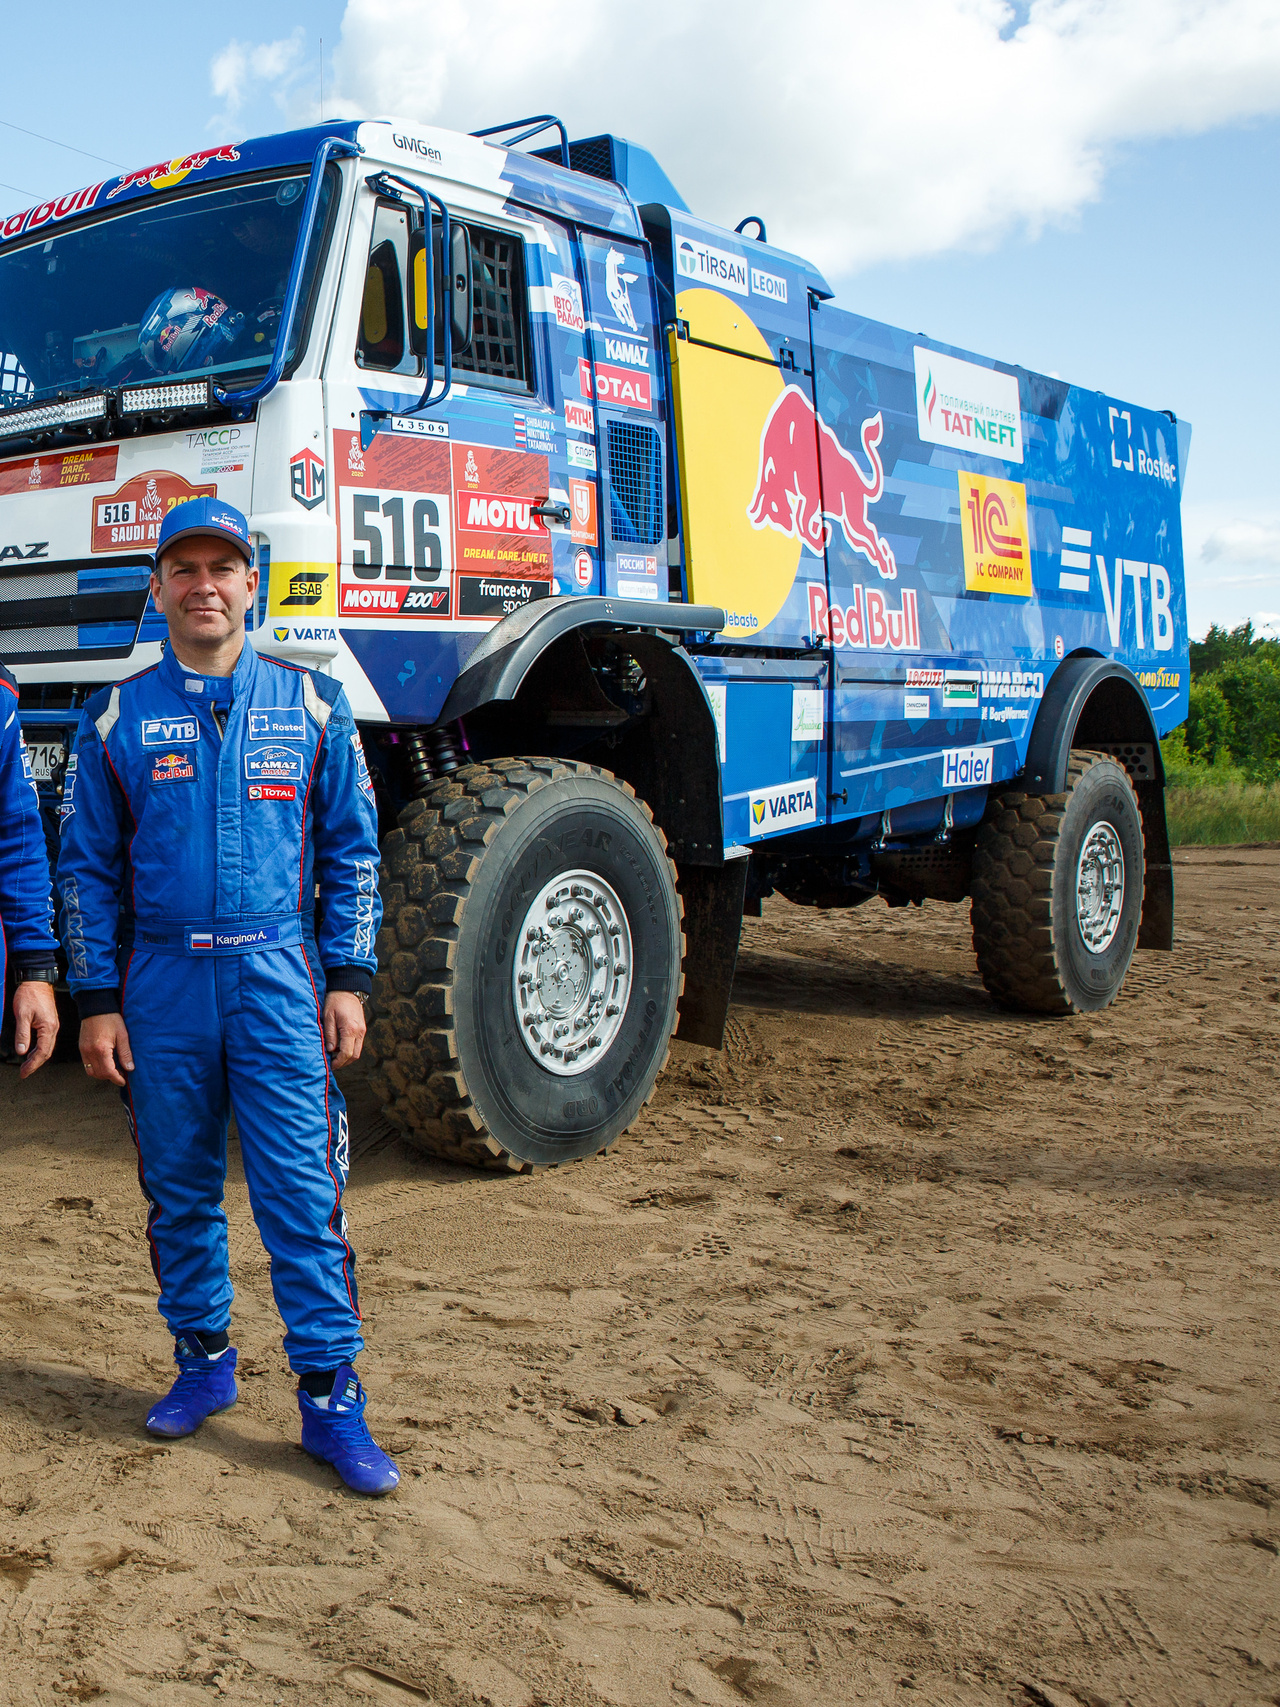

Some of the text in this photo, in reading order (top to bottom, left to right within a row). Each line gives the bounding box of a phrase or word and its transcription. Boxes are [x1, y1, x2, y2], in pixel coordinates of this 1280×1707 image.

[392, 133, 442, 161] GMGen
[753, 272, 786, 299] LEONI
[557, 311, 583, 330] РАДИО
[605, 338, 649, 367] KAMAZ
[581, 366, 648, 404] TOTAL
[940, 393, 1016, 424] ТОПЛИВНЫЙ ПАРТНЕР
[940, 408, 1017, 448] TATNEFT
[62, 452, 94, 466] DREAM.
[1137, 448, 1177, 482] Rostec
[60, 464, 86, 475] DARE.
[60, 472, 91, 485] LIVE IT.
[103, 505, 130, 523] 516
[111, 528, 144, 543] SAUDI
[352, 493, 442, 582] 516
[463, 547, 548, 564] DREAM. DARE. LIVE IT.
[619, 558, 656, 571] РОССИЯ 24
[987, 564, 1024, 581] COMPANY
[289, 582, 323, 596] ESAB
[343, 589, 448, 609] MOTUL 300V
[1095, 554, 1174, 651] VTB
[724, 610, 759, 627] ebasto
[808, 584, 919, 649] Red Bull
[293, 627, 337, 641] VARTA
[906, 670, 942, 686] LOCTITE
[981, 670, 1044, 698] WABCO
[161, 722, 196, 740] VTB
[272, 723, 304, 732] Rostec
[28, 746, 58, 768] 716
[264, 749, 287, 760] Team
[35, 768, 50, 777] RUS
[152, 766, 194, 781] Red Bull
[250, 761, 298, 770] KAMAZ
[261, 768, 291, 776] master
[946, 750, 990, 784] Haier
[263, 788, 294, 798] TOTAL
[769, 789, 814, 818] VARTA
[257, 930, 267, 940] A.
